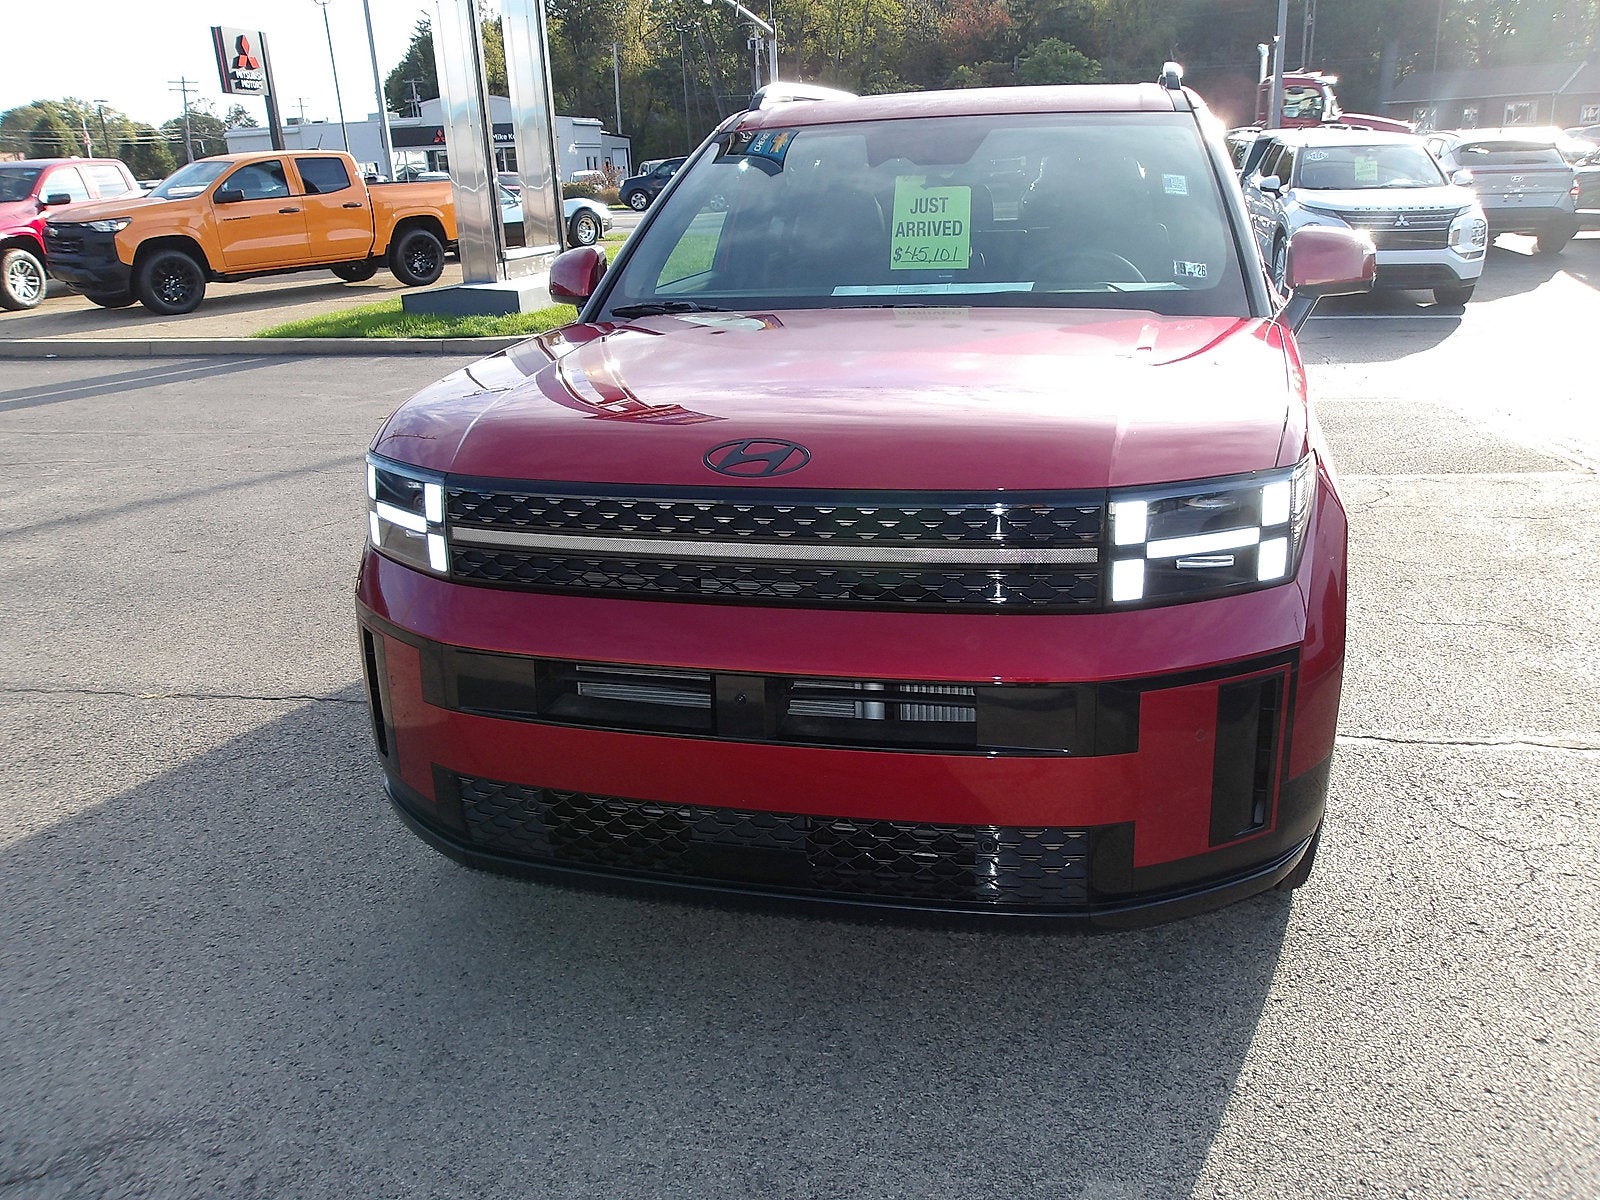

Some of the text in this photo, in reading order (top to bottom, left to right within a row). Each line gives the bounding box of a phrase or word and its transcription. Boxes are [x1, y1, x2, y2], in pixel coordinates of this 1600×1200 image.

[241, 80, 263, 90] MOTORS
[909, 197, 949, 214] JUST
[895, 220, 963, 238] ARRIVED
[893, 245, 959, 264] $45,101
[1197, 264, 1206, 277] 26
